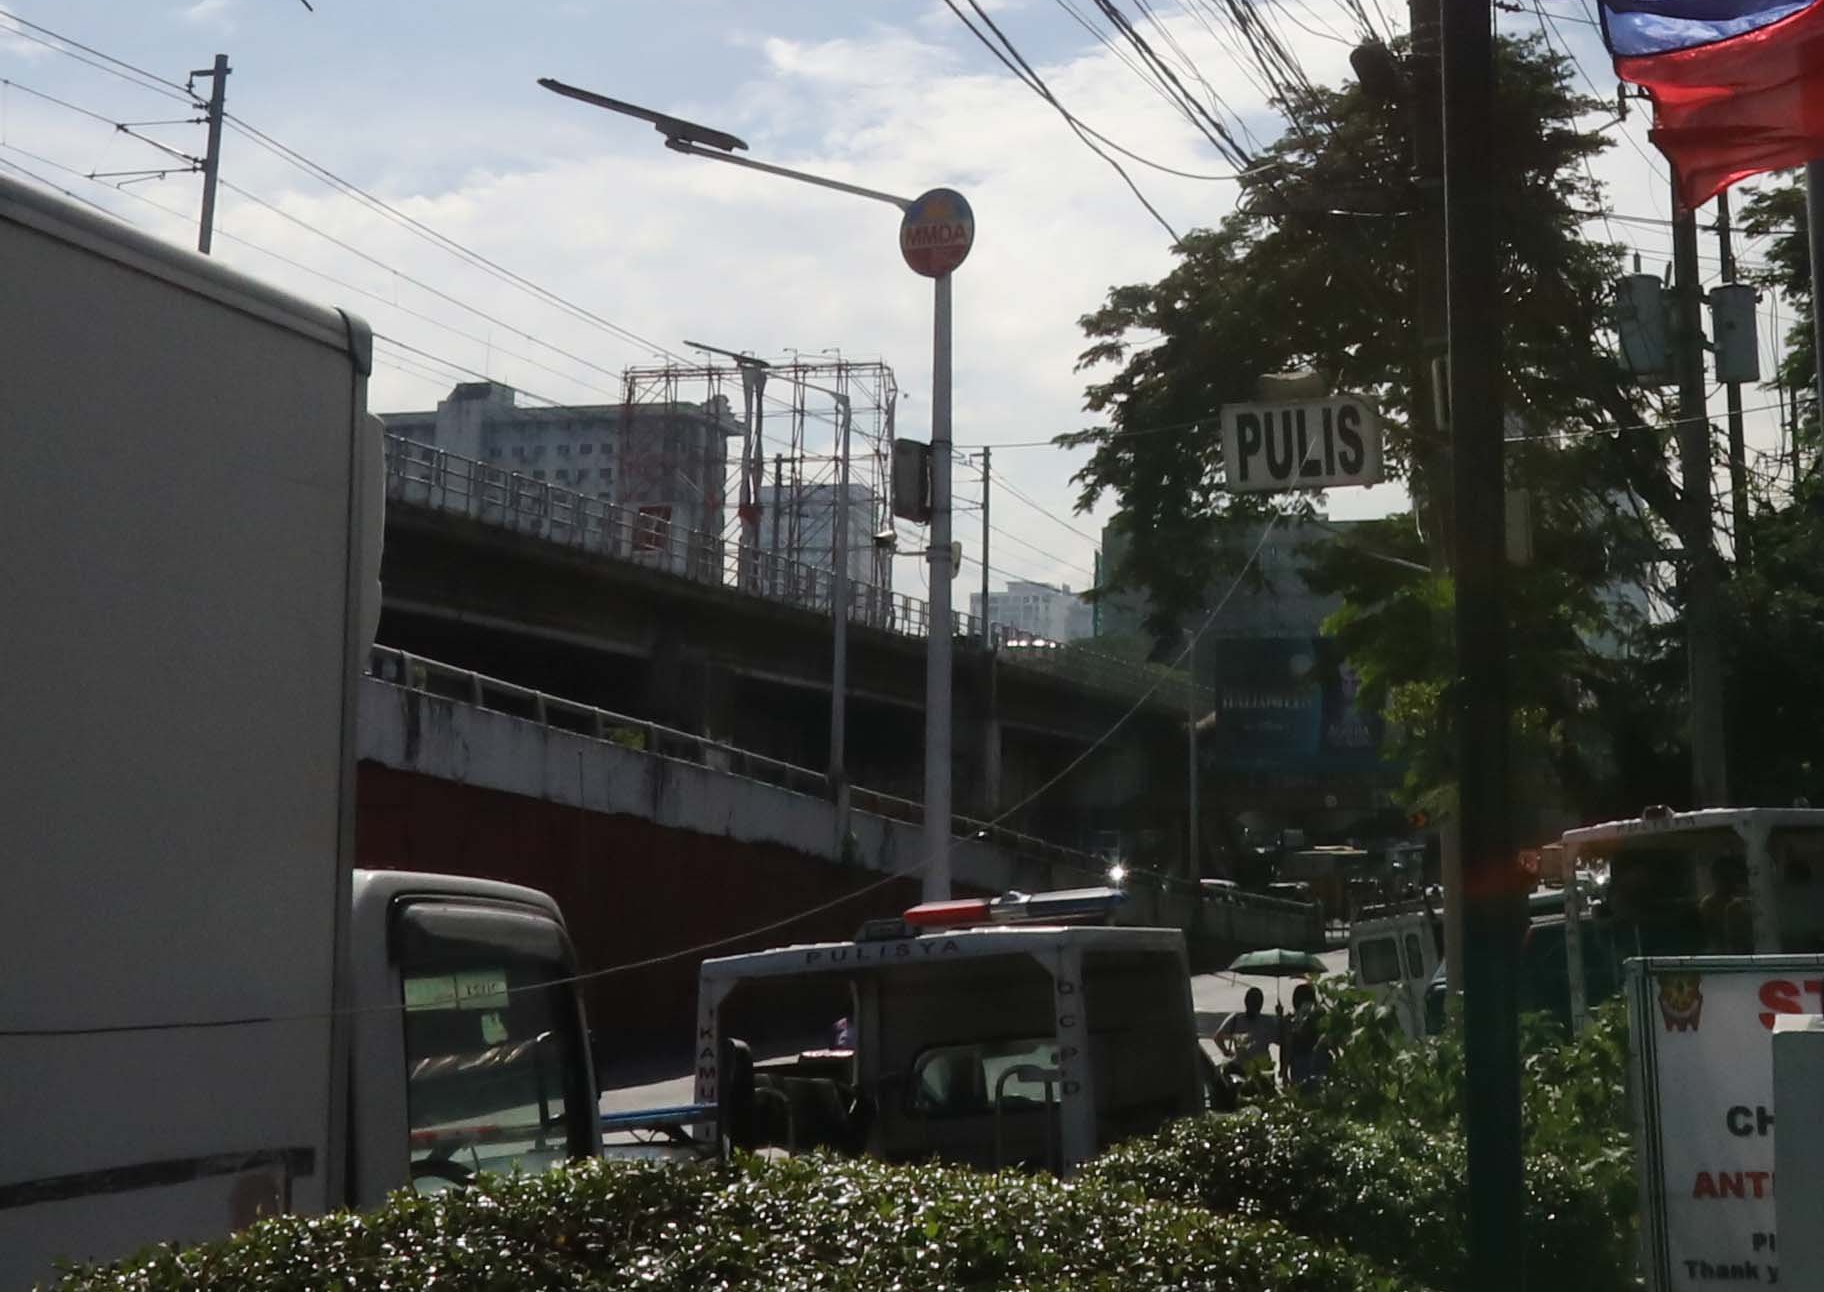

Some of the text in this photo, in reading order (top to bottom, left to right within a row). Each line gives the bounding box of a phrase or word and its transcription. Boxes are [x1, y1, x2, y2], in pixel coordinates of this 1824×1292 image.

[1235, 403, 1365, 482] PULIS
[806, 939, 961, 965] PULISYA
[1683, 1260, 1761, 1281] Thank
